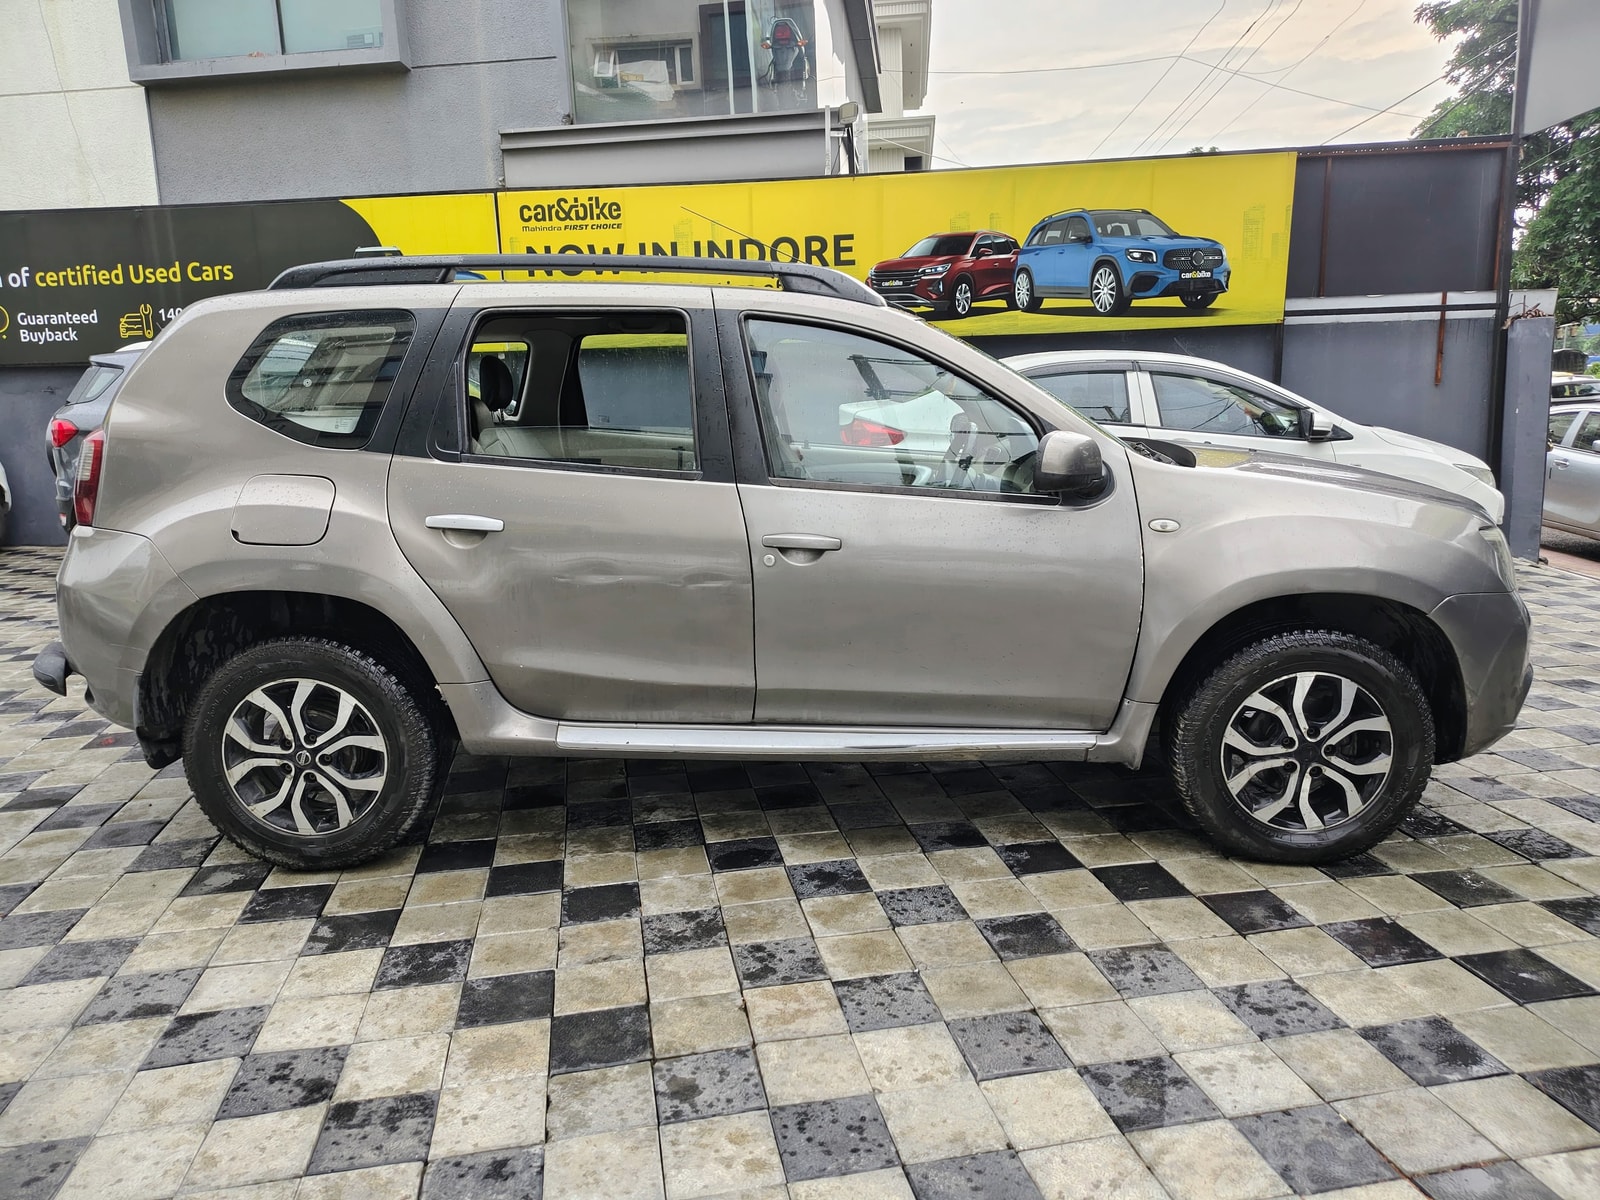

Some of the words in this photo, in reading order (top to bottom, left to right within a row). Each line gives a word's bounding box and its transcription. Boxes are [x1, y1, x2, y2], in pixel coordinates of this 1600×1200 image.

[519, 196, 622, 223] car&bike
[693, 233, 856, 267] INDORE
[8, 266, 30, 288] of
[35, 264, 124, 288] certified
[128, 260, 182, 285] Used
[186, 261, 234, 282] Cars
[17, 309, 98, 326] Guaranteed
[19, 327, 79, 345] Buyback
